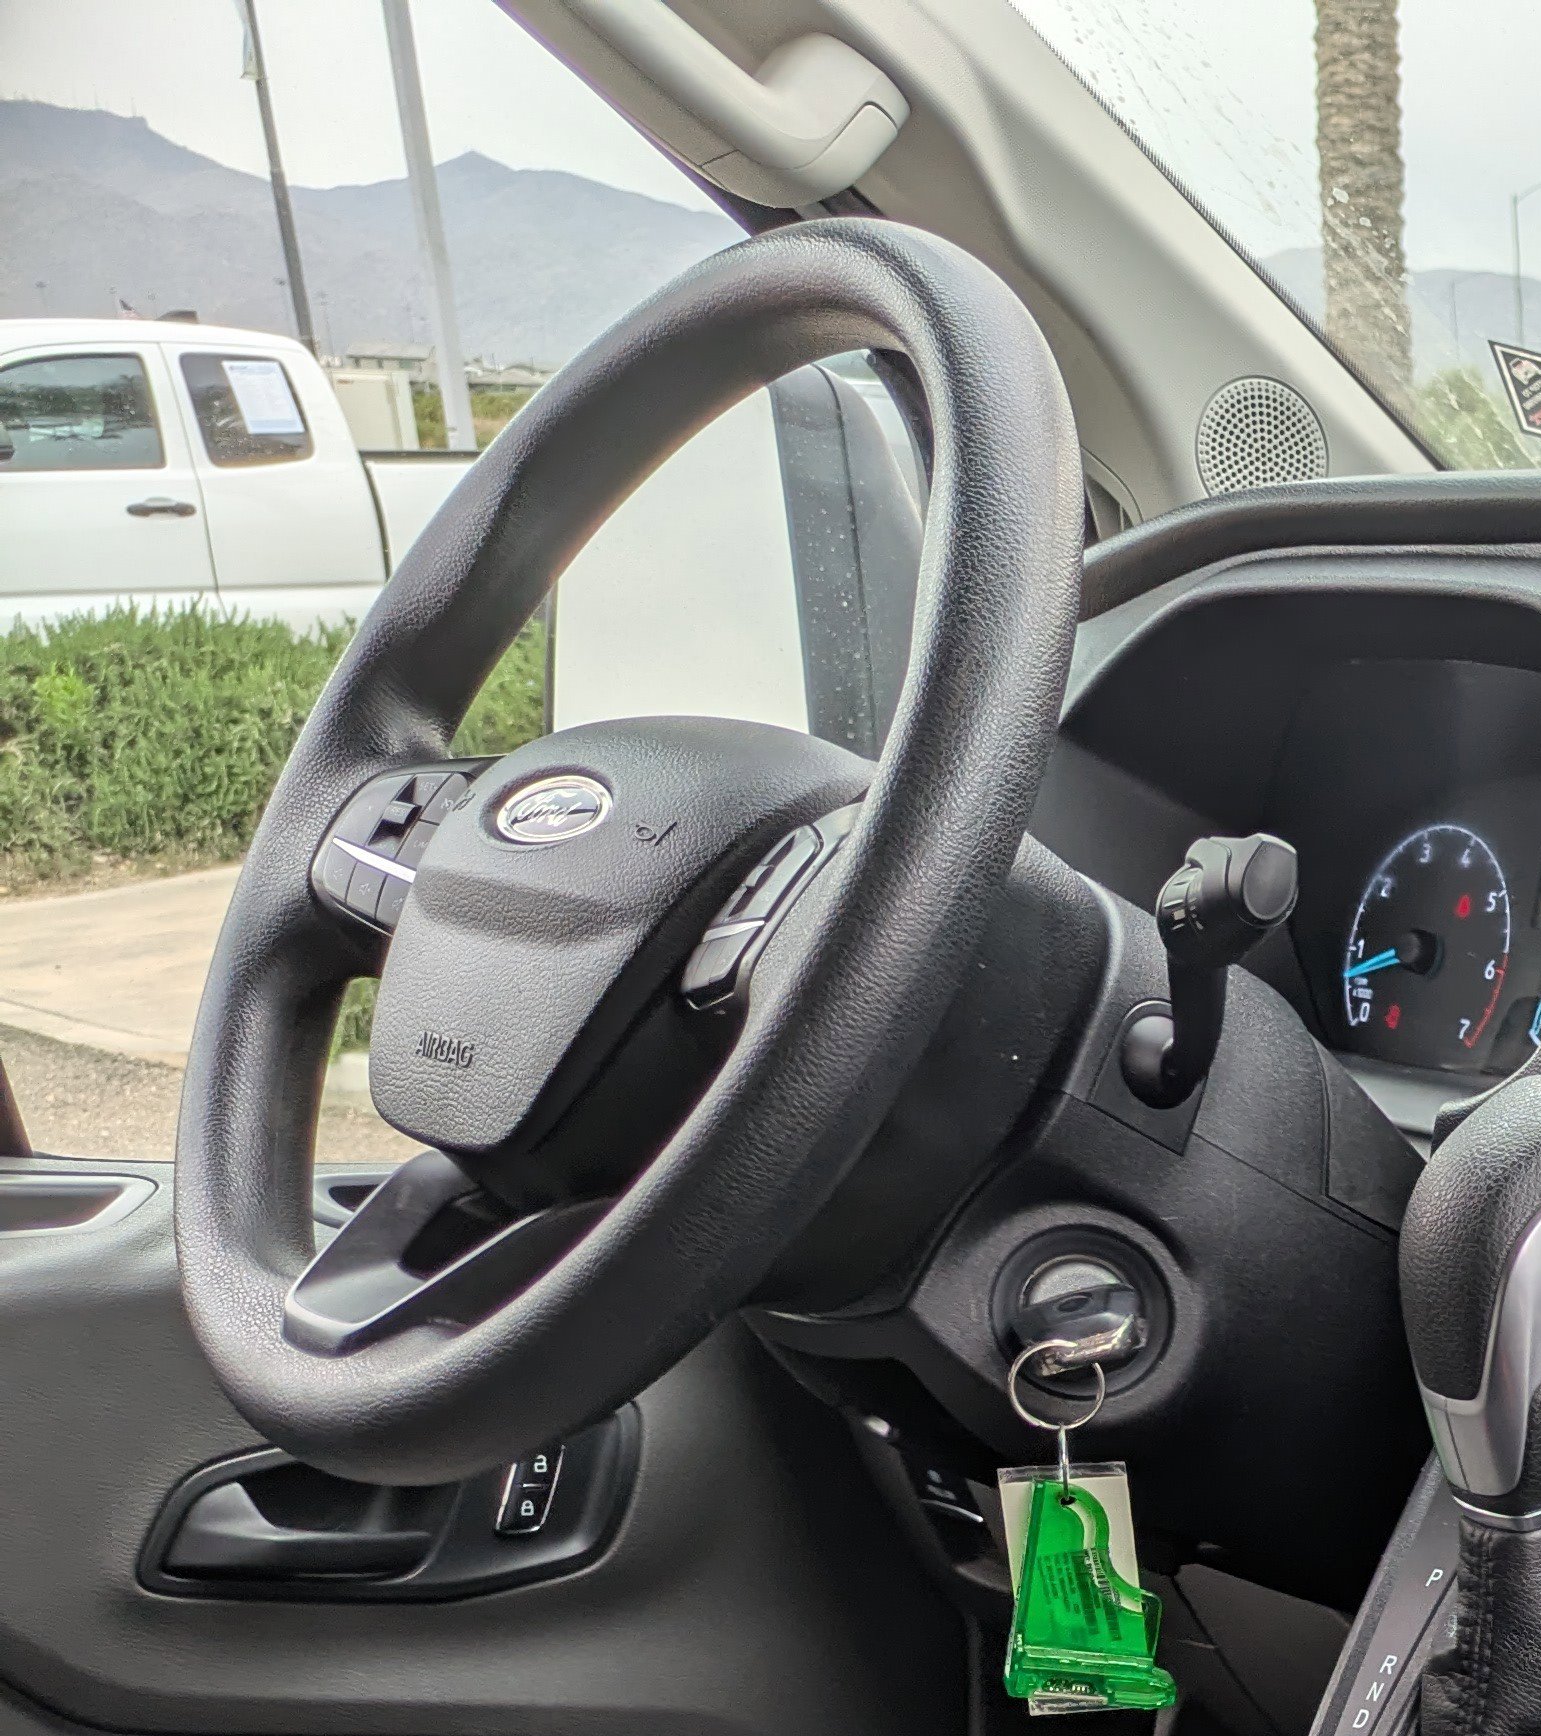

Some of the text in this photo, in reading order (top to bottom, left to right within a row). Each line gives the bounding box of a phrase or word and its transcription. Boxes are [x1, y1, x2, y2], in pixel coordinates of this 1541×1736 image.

[1419, 844, 1432, 863] 3
[1381, 877, 1392, 897] 2
[1487, 892, 1496, 912] 5
[1484, 960, 1495, 980] 6
[1359, 1002, 1370, 1022] 0
[1458, 1019, 1470, 1039] 7
[415, 1031, 475, 1068] AIRBAG
[1425, 1568, 1443, 1587] P
[1379, 1655, 1398, 1675] R
[1366, 1681, 1384, 1702] N
[1352, 1709, 1370, 1729] D
